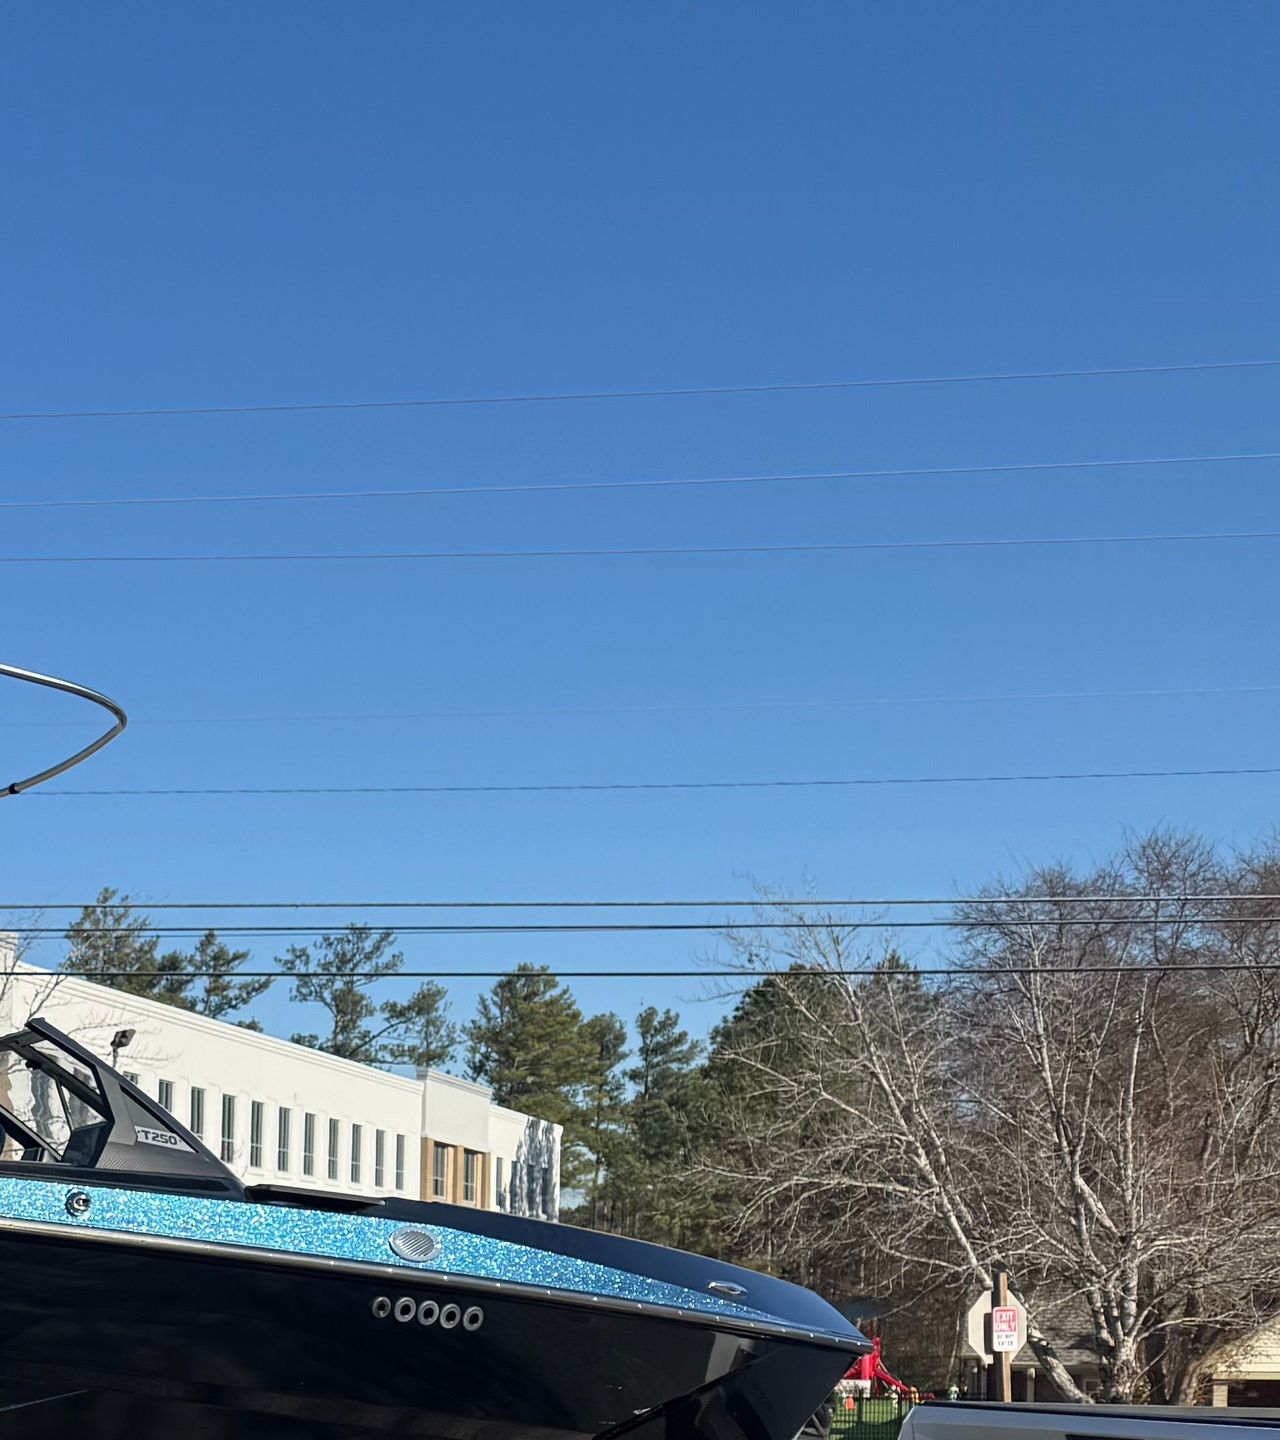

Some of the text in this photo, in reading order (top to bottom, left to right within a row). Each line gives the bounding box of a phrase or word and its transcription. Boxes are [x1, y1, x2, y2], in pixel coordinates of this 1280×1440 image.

[141, 1130, 178, 1145] T250
[996, 1311, 1014, 1321] EXIT
[995, 1321, 1016, 1331] ONLY
